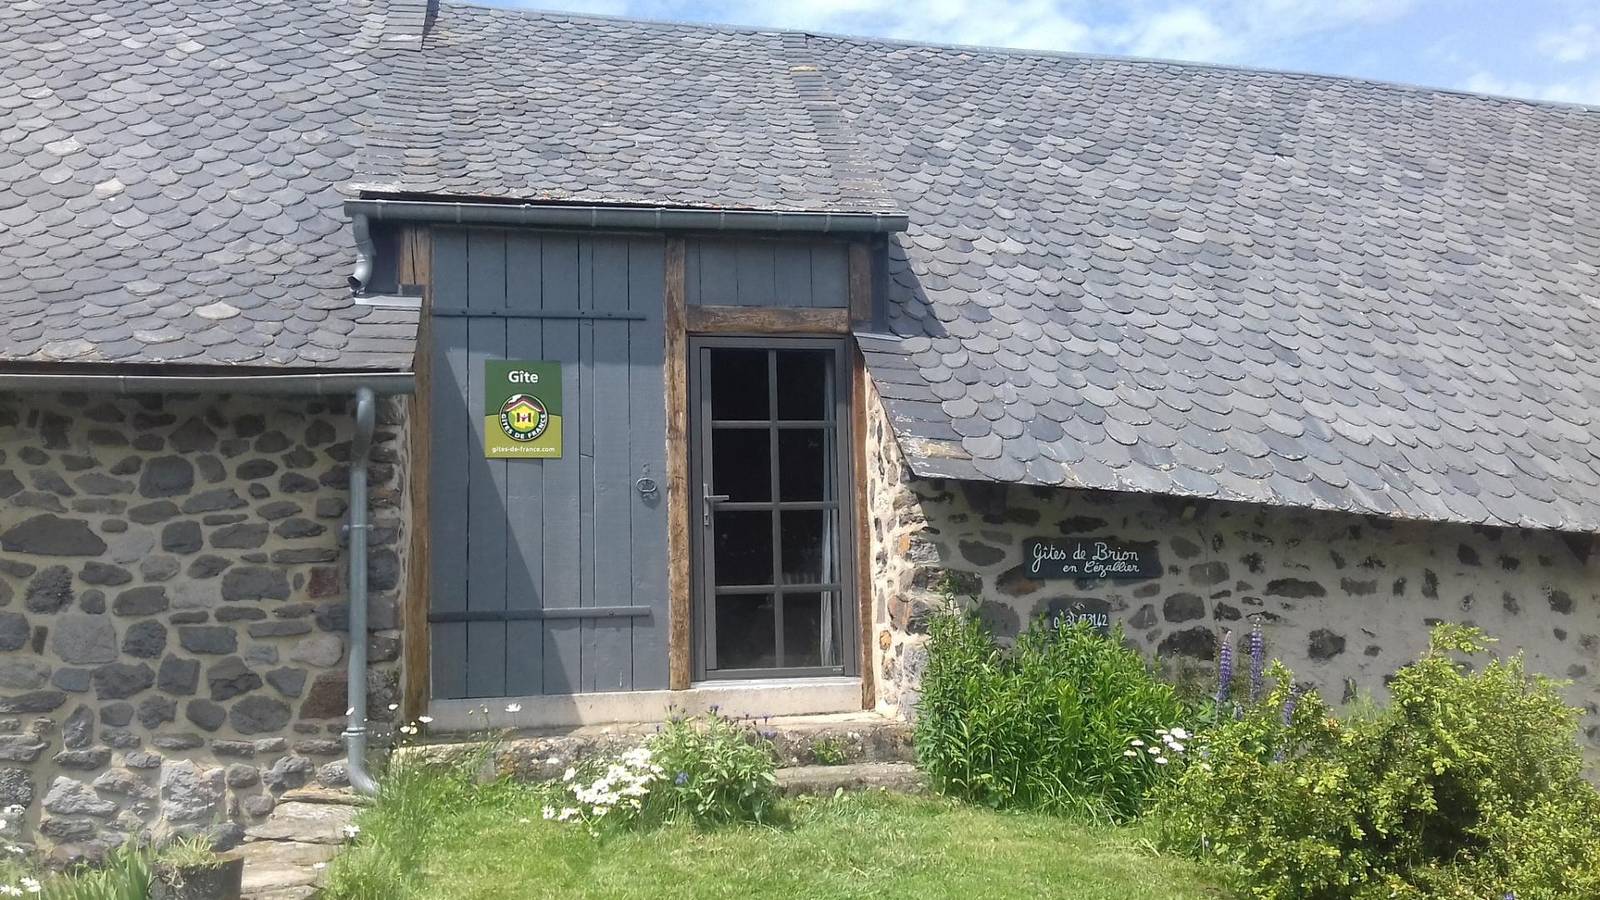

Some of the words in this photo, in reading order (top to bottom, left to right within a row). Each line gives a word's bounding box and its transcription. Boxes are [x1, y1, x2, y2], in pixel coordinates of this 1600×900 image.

[508, 370, 539, 383] Gîte
[527, 413, 546, 438] FRANCE
[1031, 542, 1066, 573] Gîtes
[1073, 542, 1087, 560] de
[1092, 541, 1139, 561] Brion
[1062, 565, 1078, 573] en
